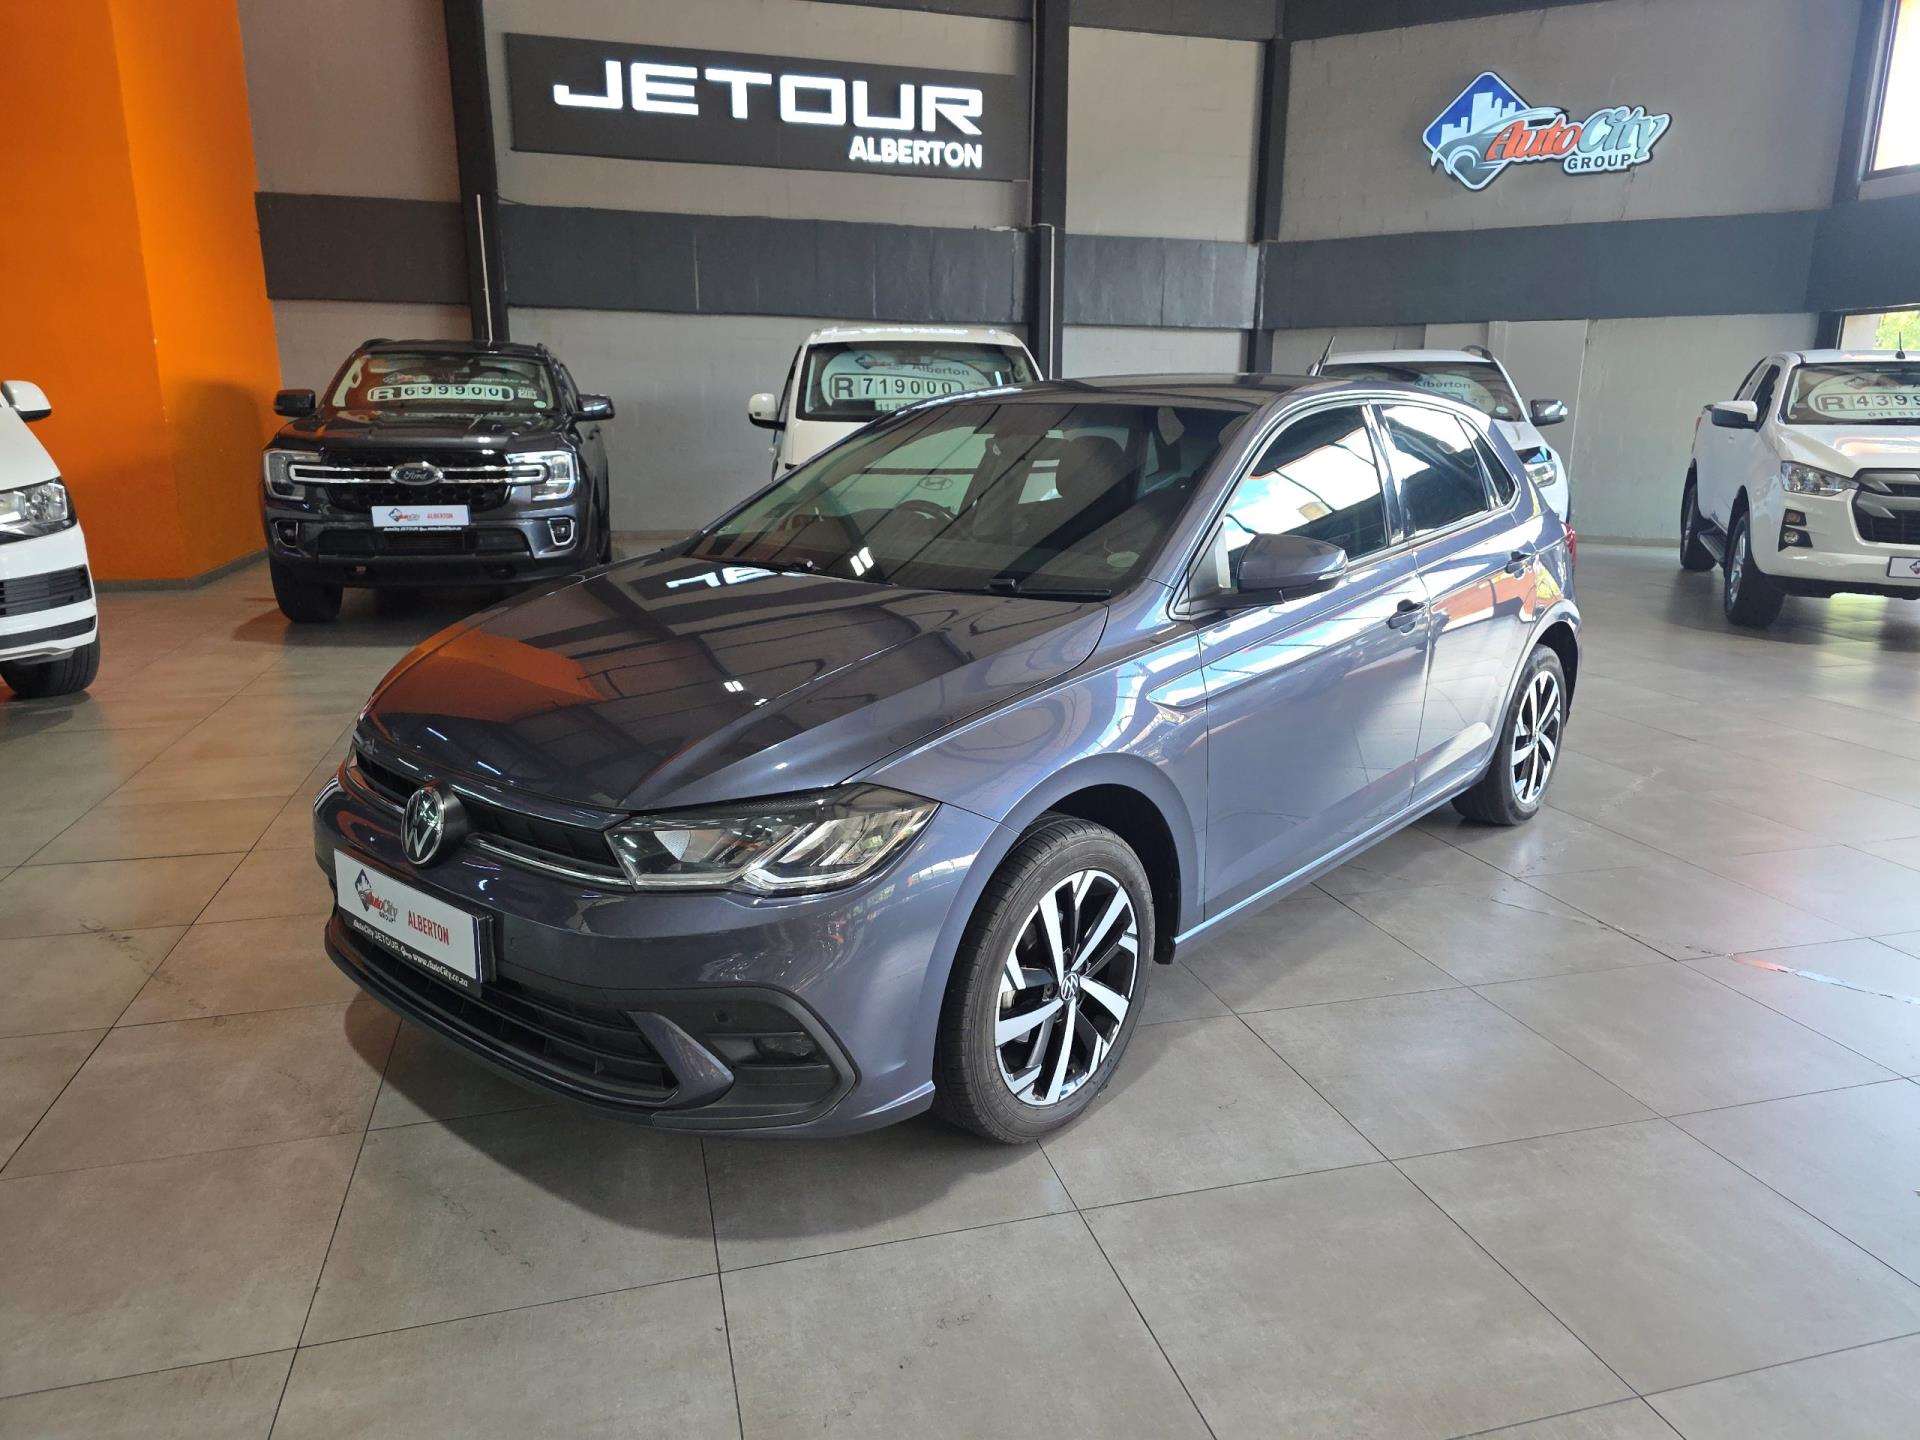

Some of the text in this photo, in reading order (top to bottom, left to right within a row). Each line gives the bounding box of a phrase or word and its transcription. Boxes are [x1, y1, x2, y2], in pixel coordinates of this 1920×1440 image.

[553, 60, 983, 135] JETOUR
[849, 135, 983, 168] ALBERTON
[1567, 153, 1632, 171] GROUP
[408, 910, 450, 943] ALBERTON
